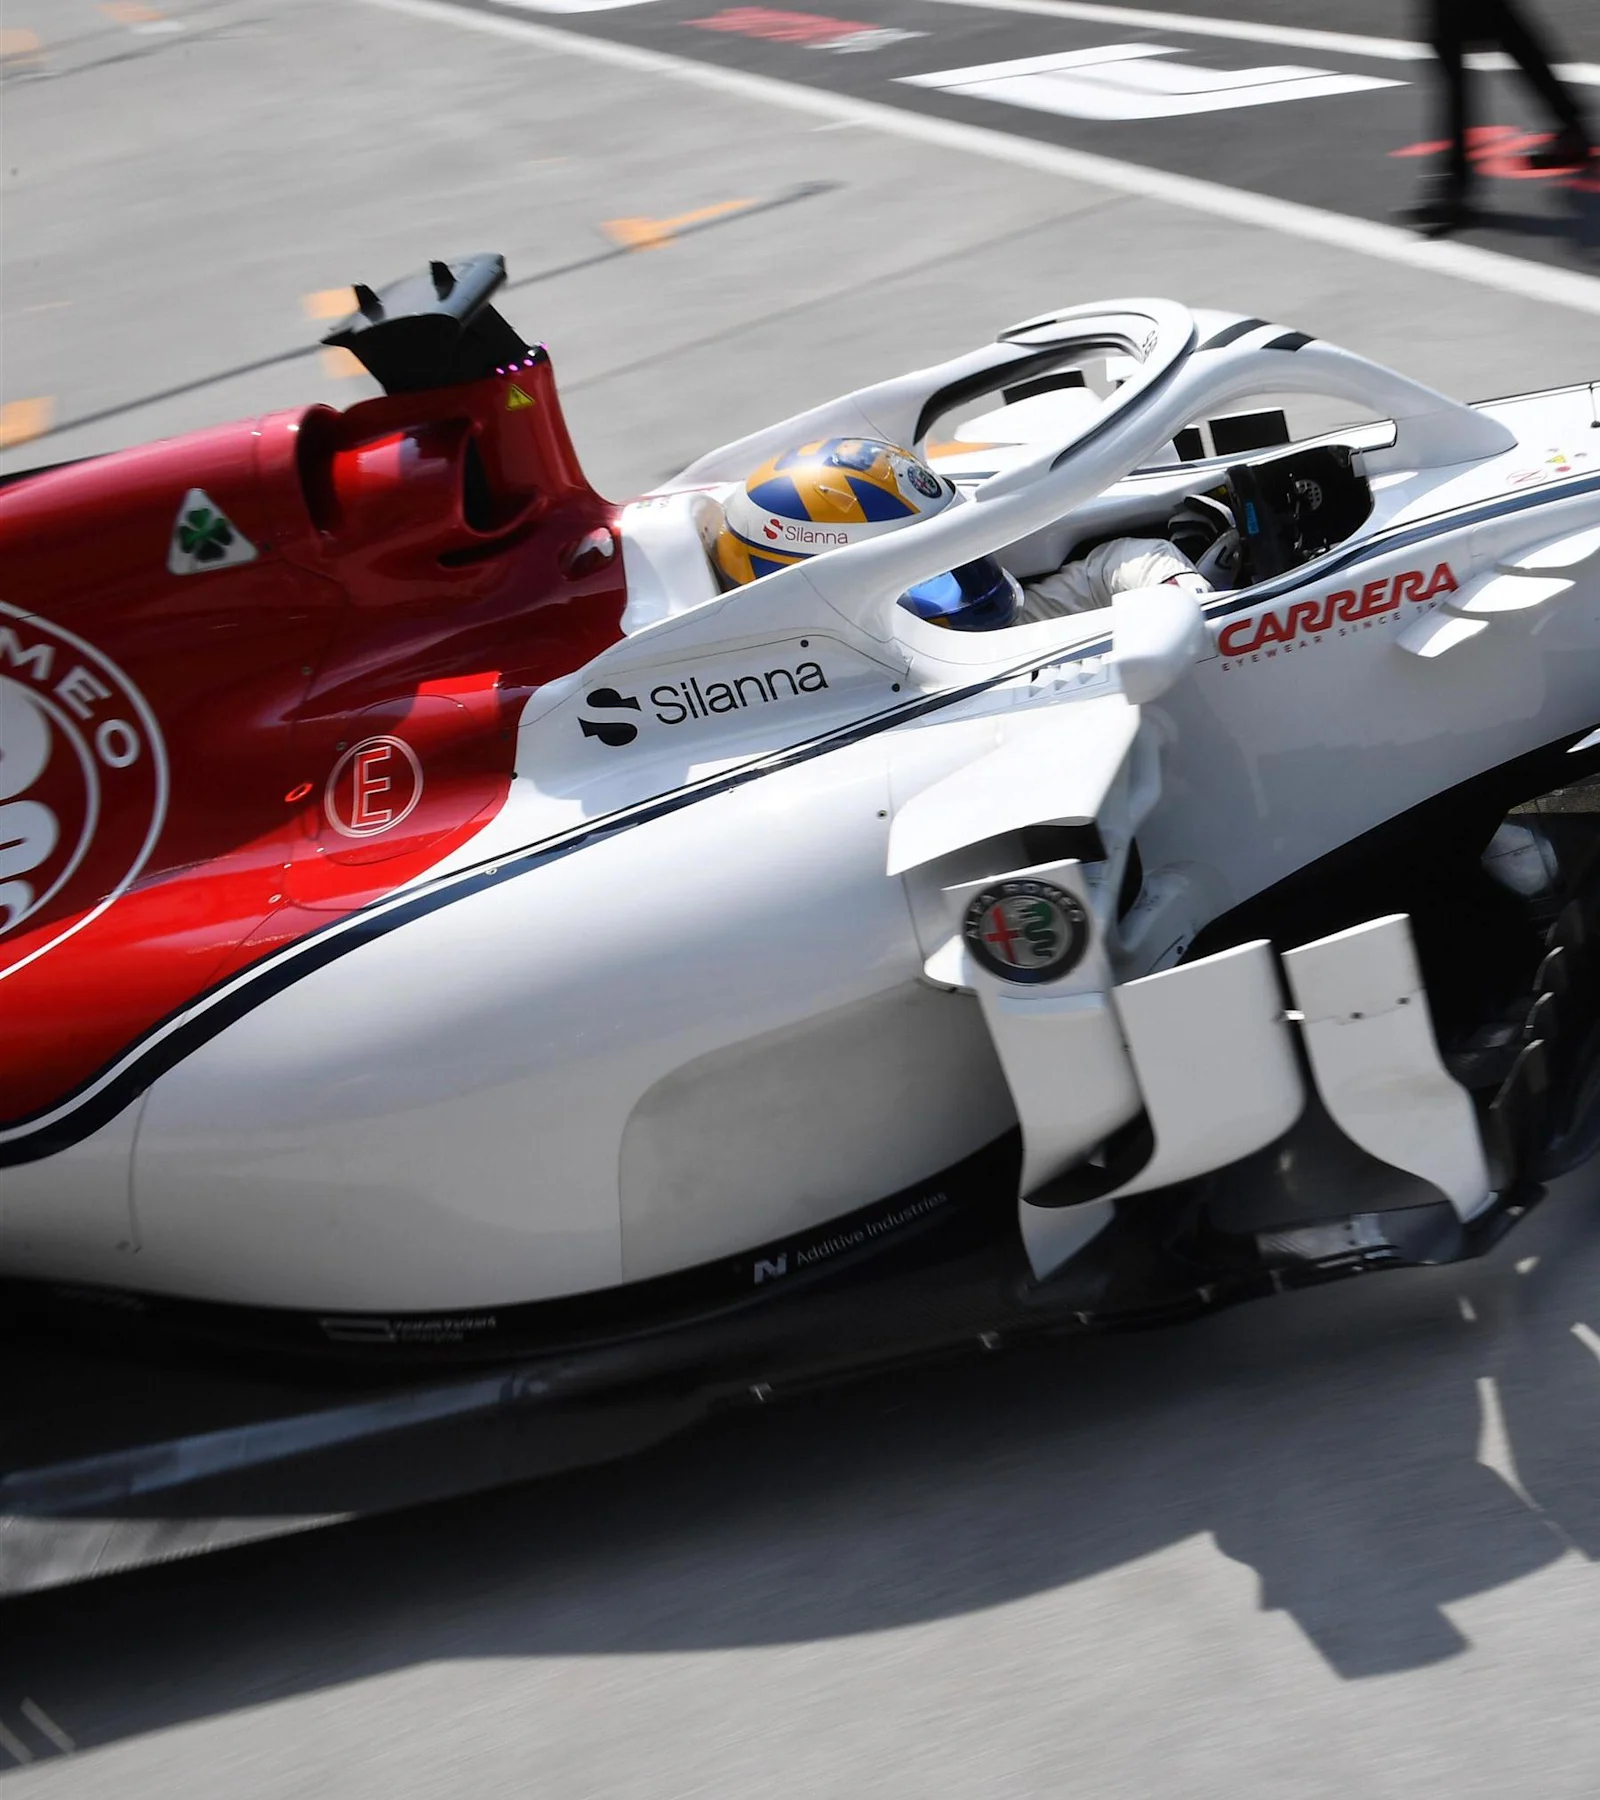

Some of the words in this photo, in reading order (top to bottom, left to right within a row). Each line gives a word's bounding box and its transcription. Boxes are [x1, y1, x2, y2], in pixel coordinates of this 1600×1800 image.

[784, 525, 849, 545] Silanna
[1217, 561, 1459, 657] CARRERA
[1221, 635, 1323, 672] EYEWEAR
[1339, 611, 1402, 637] SINCE
[650, 661, 830, 725] Silanna
[351, 745, 392, 829] E
[797, 1230, 865, 1266] Additive
[866, 1191, 947, 1237] Industries
